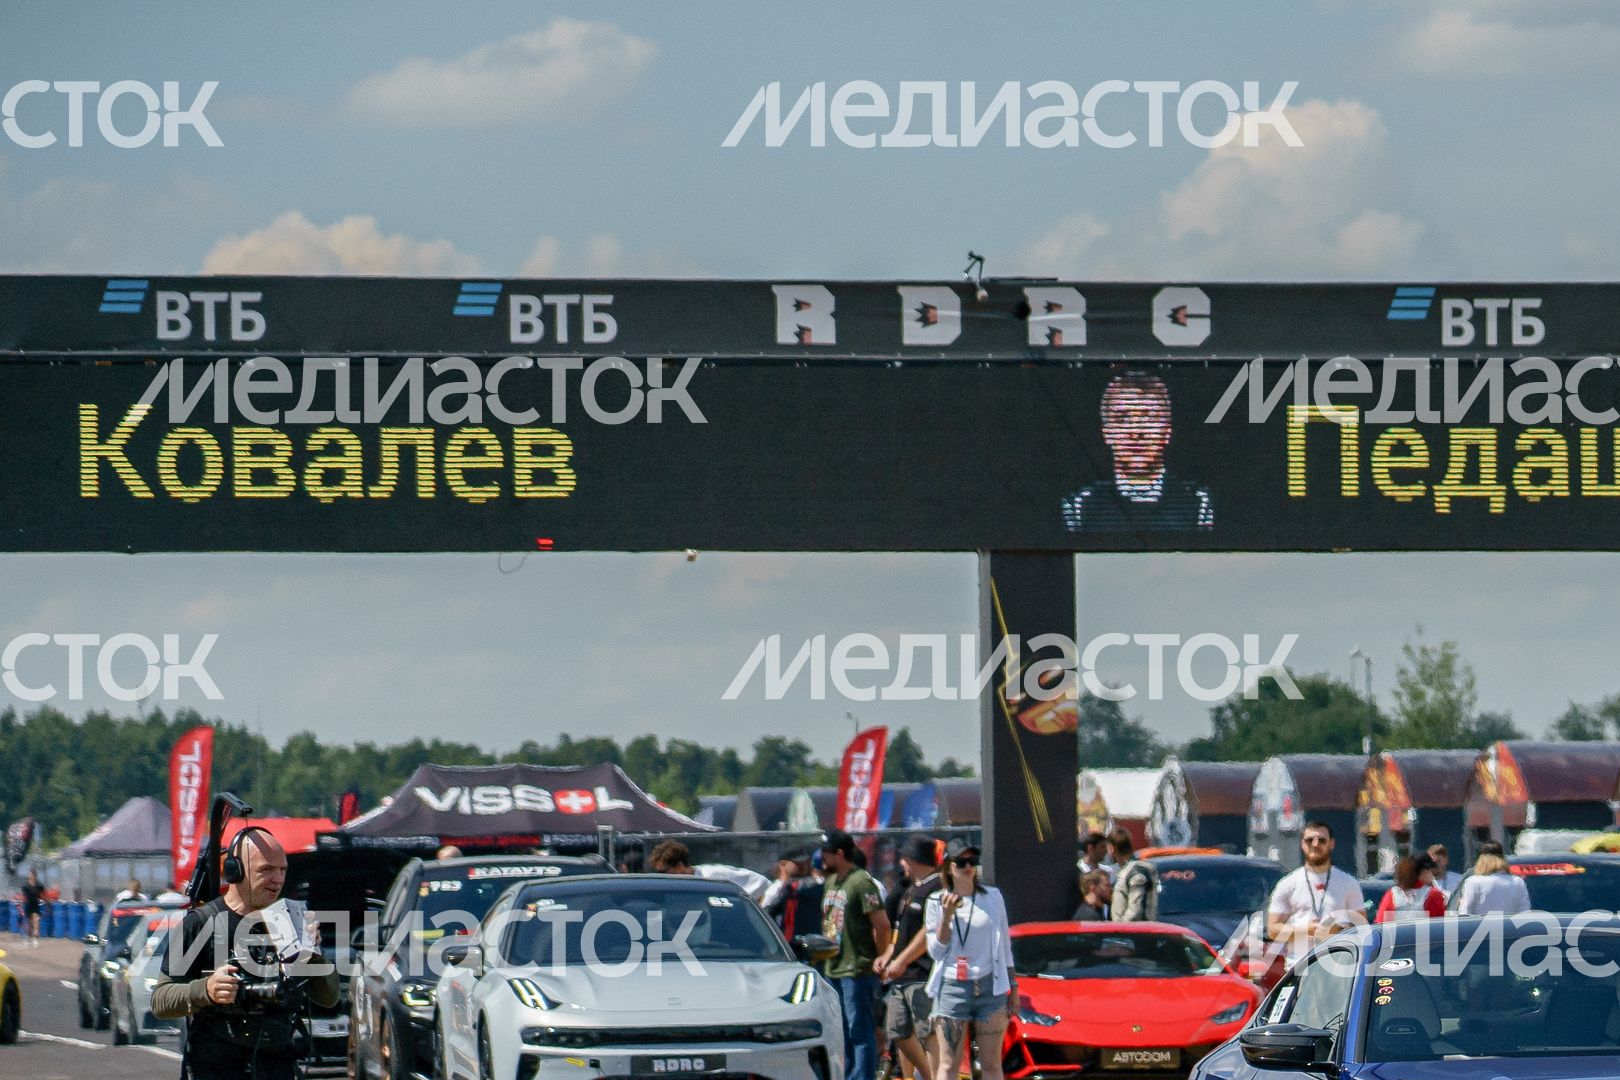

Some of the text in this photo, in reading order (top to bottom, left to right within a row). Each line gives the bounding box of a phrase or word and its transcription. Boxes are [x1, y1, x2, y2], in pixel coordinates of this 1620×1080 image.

[156, 291, 266, 341] ВТБ
[509, 294, 618, 343] ВТБ
[1441, 297, 1546, 346] ВТБ
[79, 403, 577, 503] Ковалев
